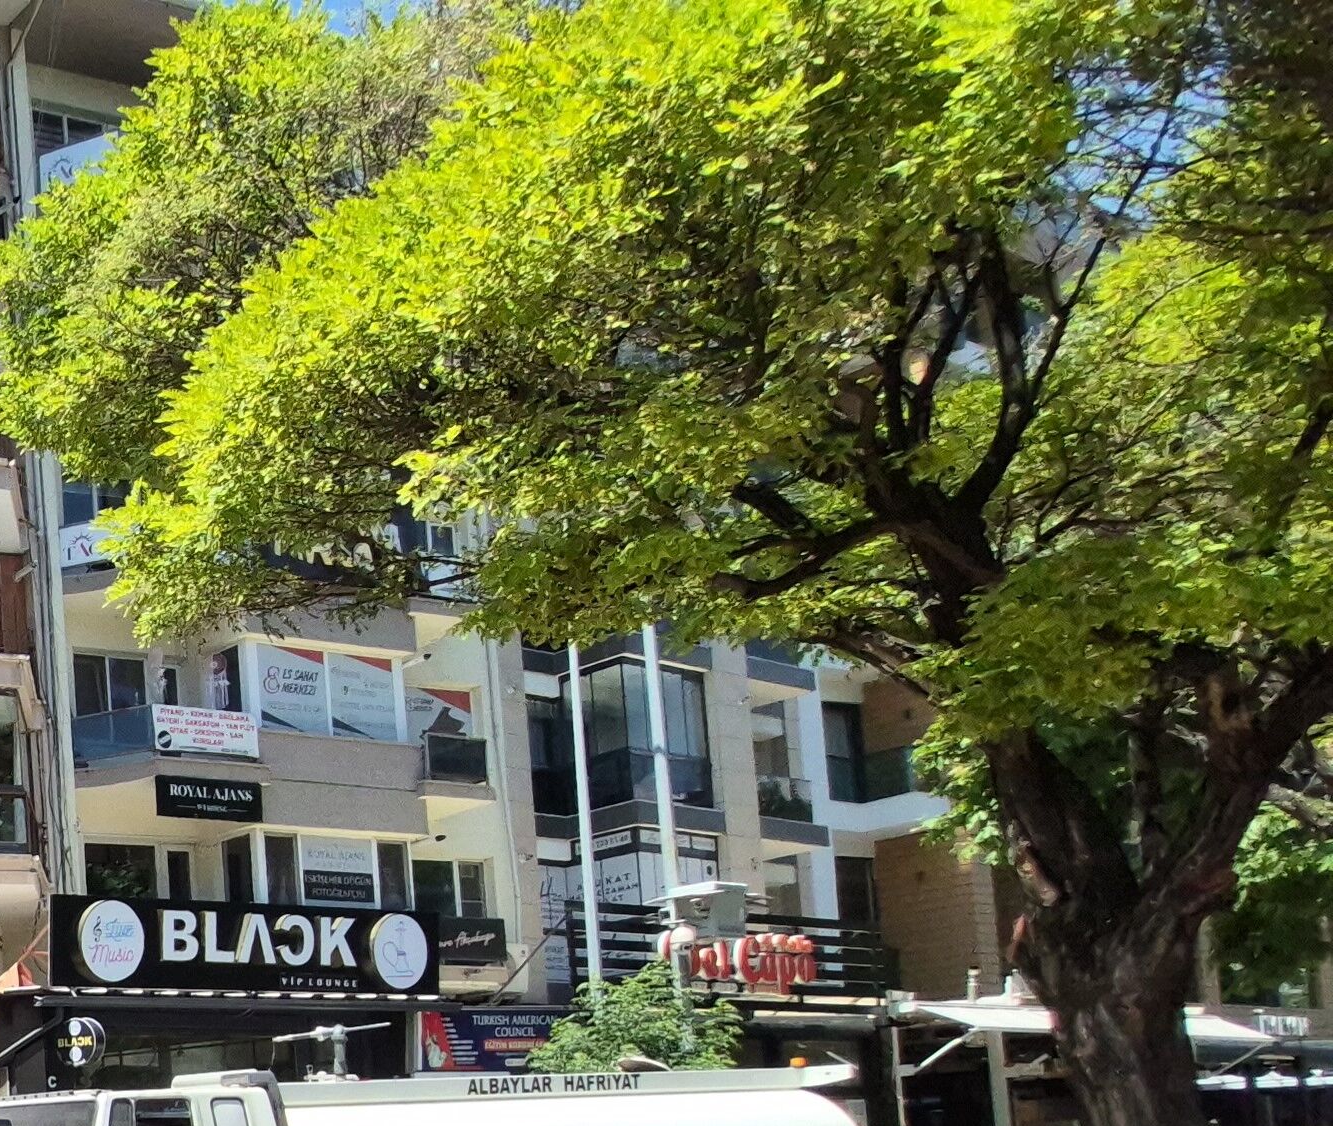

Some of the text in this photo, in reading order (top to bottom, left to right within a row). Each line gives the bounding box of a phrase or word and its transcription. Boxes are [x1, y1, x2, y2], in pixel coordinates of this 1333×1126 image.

[169, 783, 253, 802] ROYAL AJANS
[89, 944, 134, 967] Music
[308, 977, 358, 988] LOUNGE
[472, 1015, 510, 1025] TURKISH
[494, 1027, 537, 1038] COUNCIL
[468, 1073, 640, 1095] ALBAYLAR HAFRİYAT
